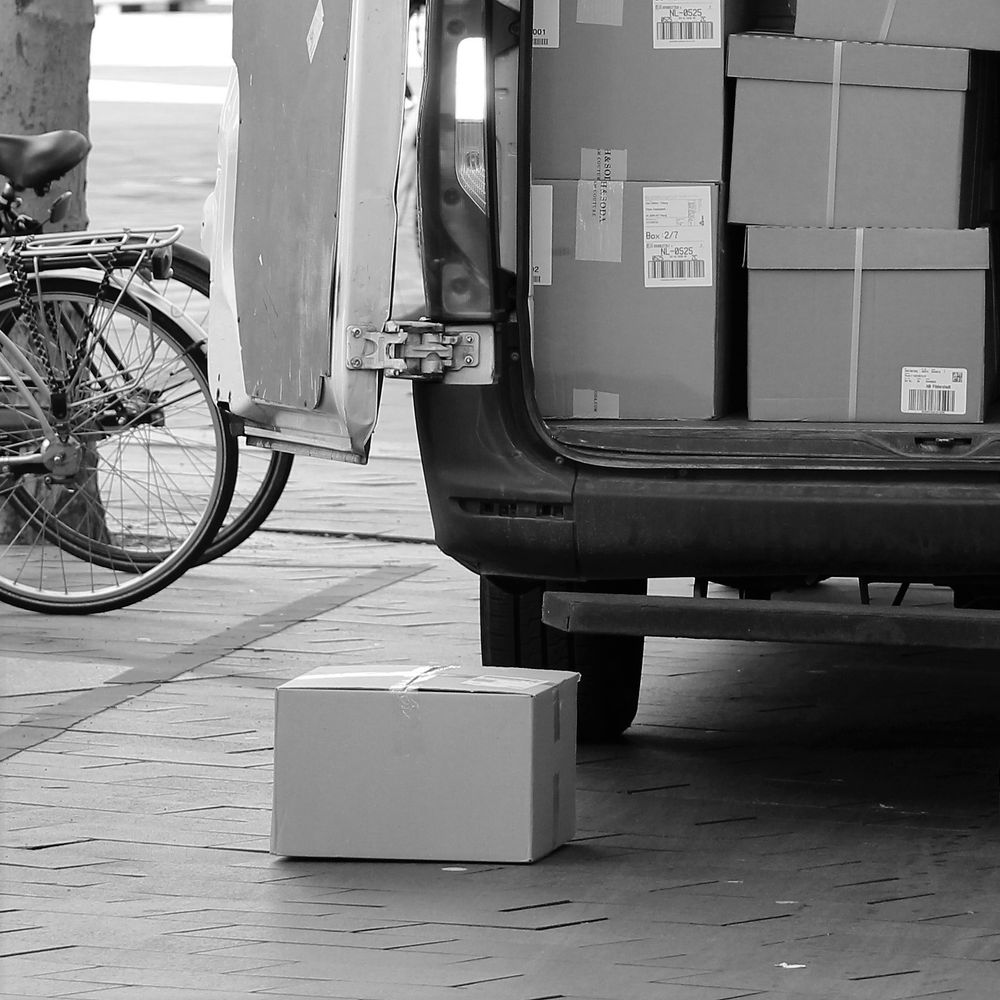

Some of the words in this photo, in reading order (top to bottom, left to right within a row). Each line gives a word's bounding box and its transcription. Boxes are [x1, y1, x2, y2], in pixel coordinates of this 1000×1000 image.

[669, 8, 703, 17] NL-0525
[664, 230, 679, 240] 2/7
[660, 247, 694, 256] NL-0525
